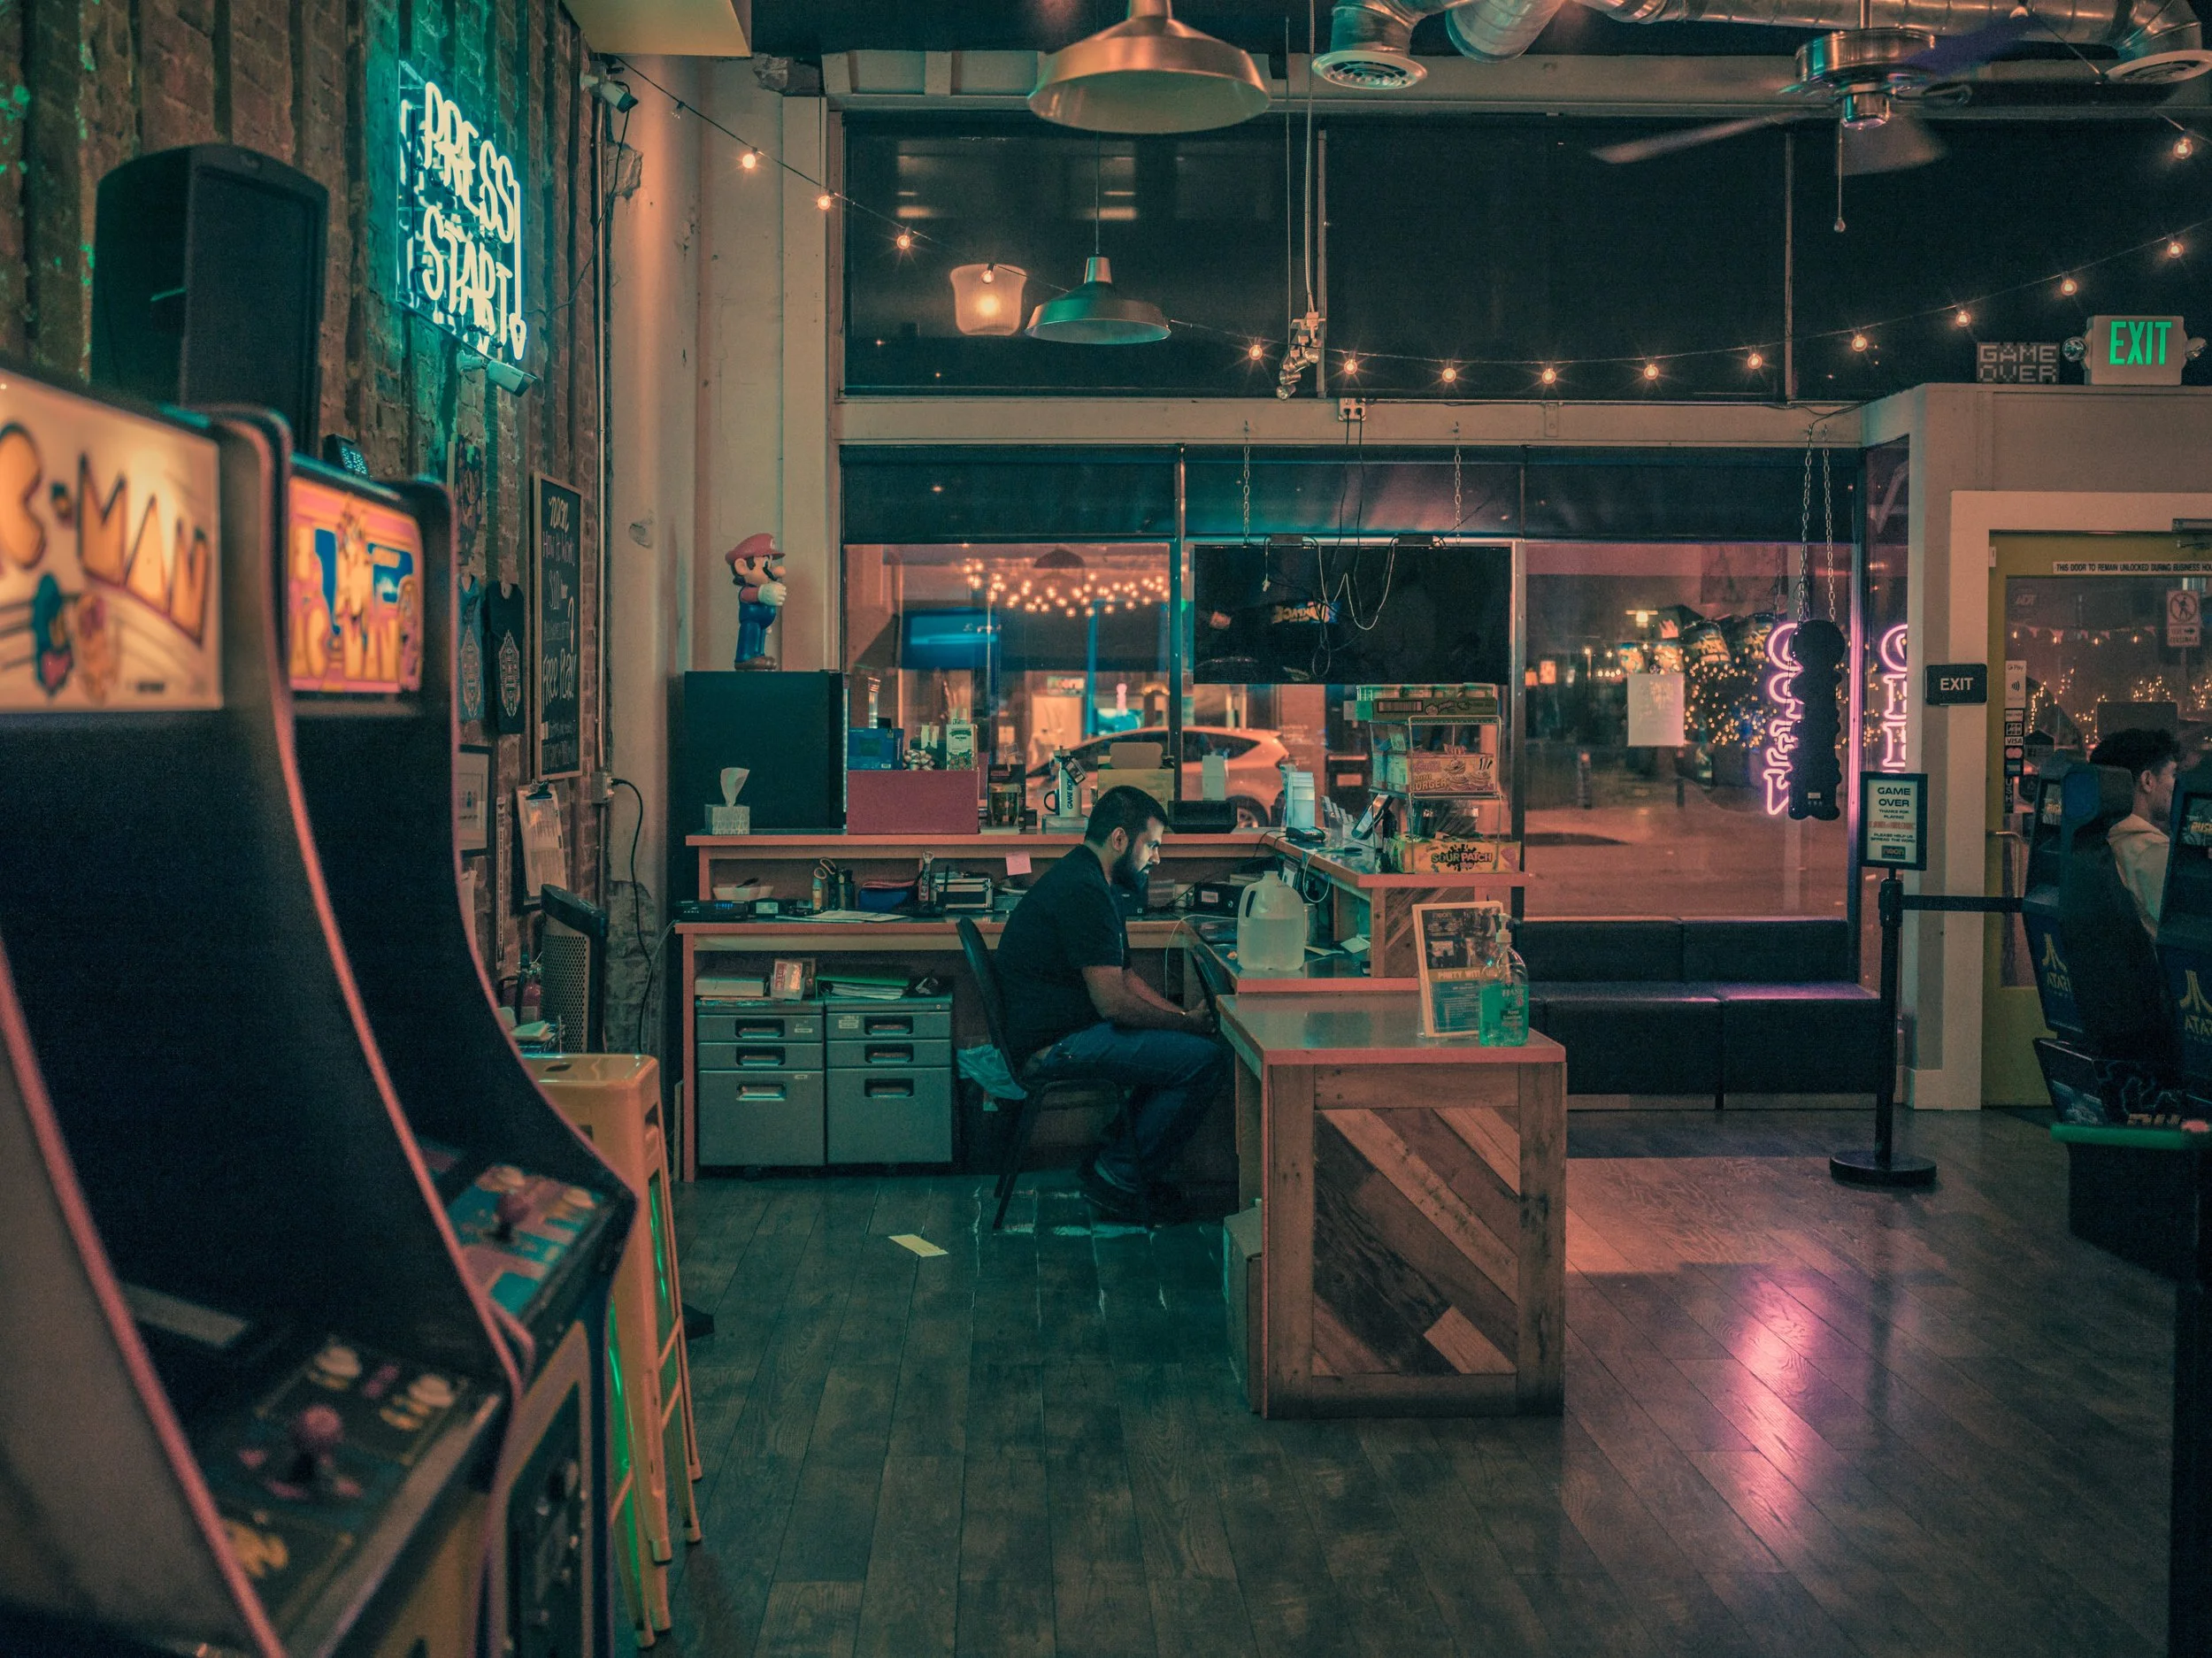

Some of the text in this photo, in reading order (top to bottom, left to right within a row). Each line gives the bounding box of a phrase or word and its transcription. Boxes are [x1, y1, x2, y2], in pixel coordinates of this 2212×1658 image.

[424, 81, 515, 243] PRESS
[2109, 321, 2171, 365] EXIT
[1979, 345, 2056, 363] GAME
[1980, 365, 2056, 382] OVER
[1940, 678, 1974, 691] EXIT
[1410, 779, 1448, 791] URGER
[1878, 787, 1910, 795] GAME
[1878, 798, 1909, 807] OVER
[2046, 802, 2062, 815] RUS
[1431, 851, 1493, 863] SOUR PATCH
[2047, 972, 2071, 993] ATARI
